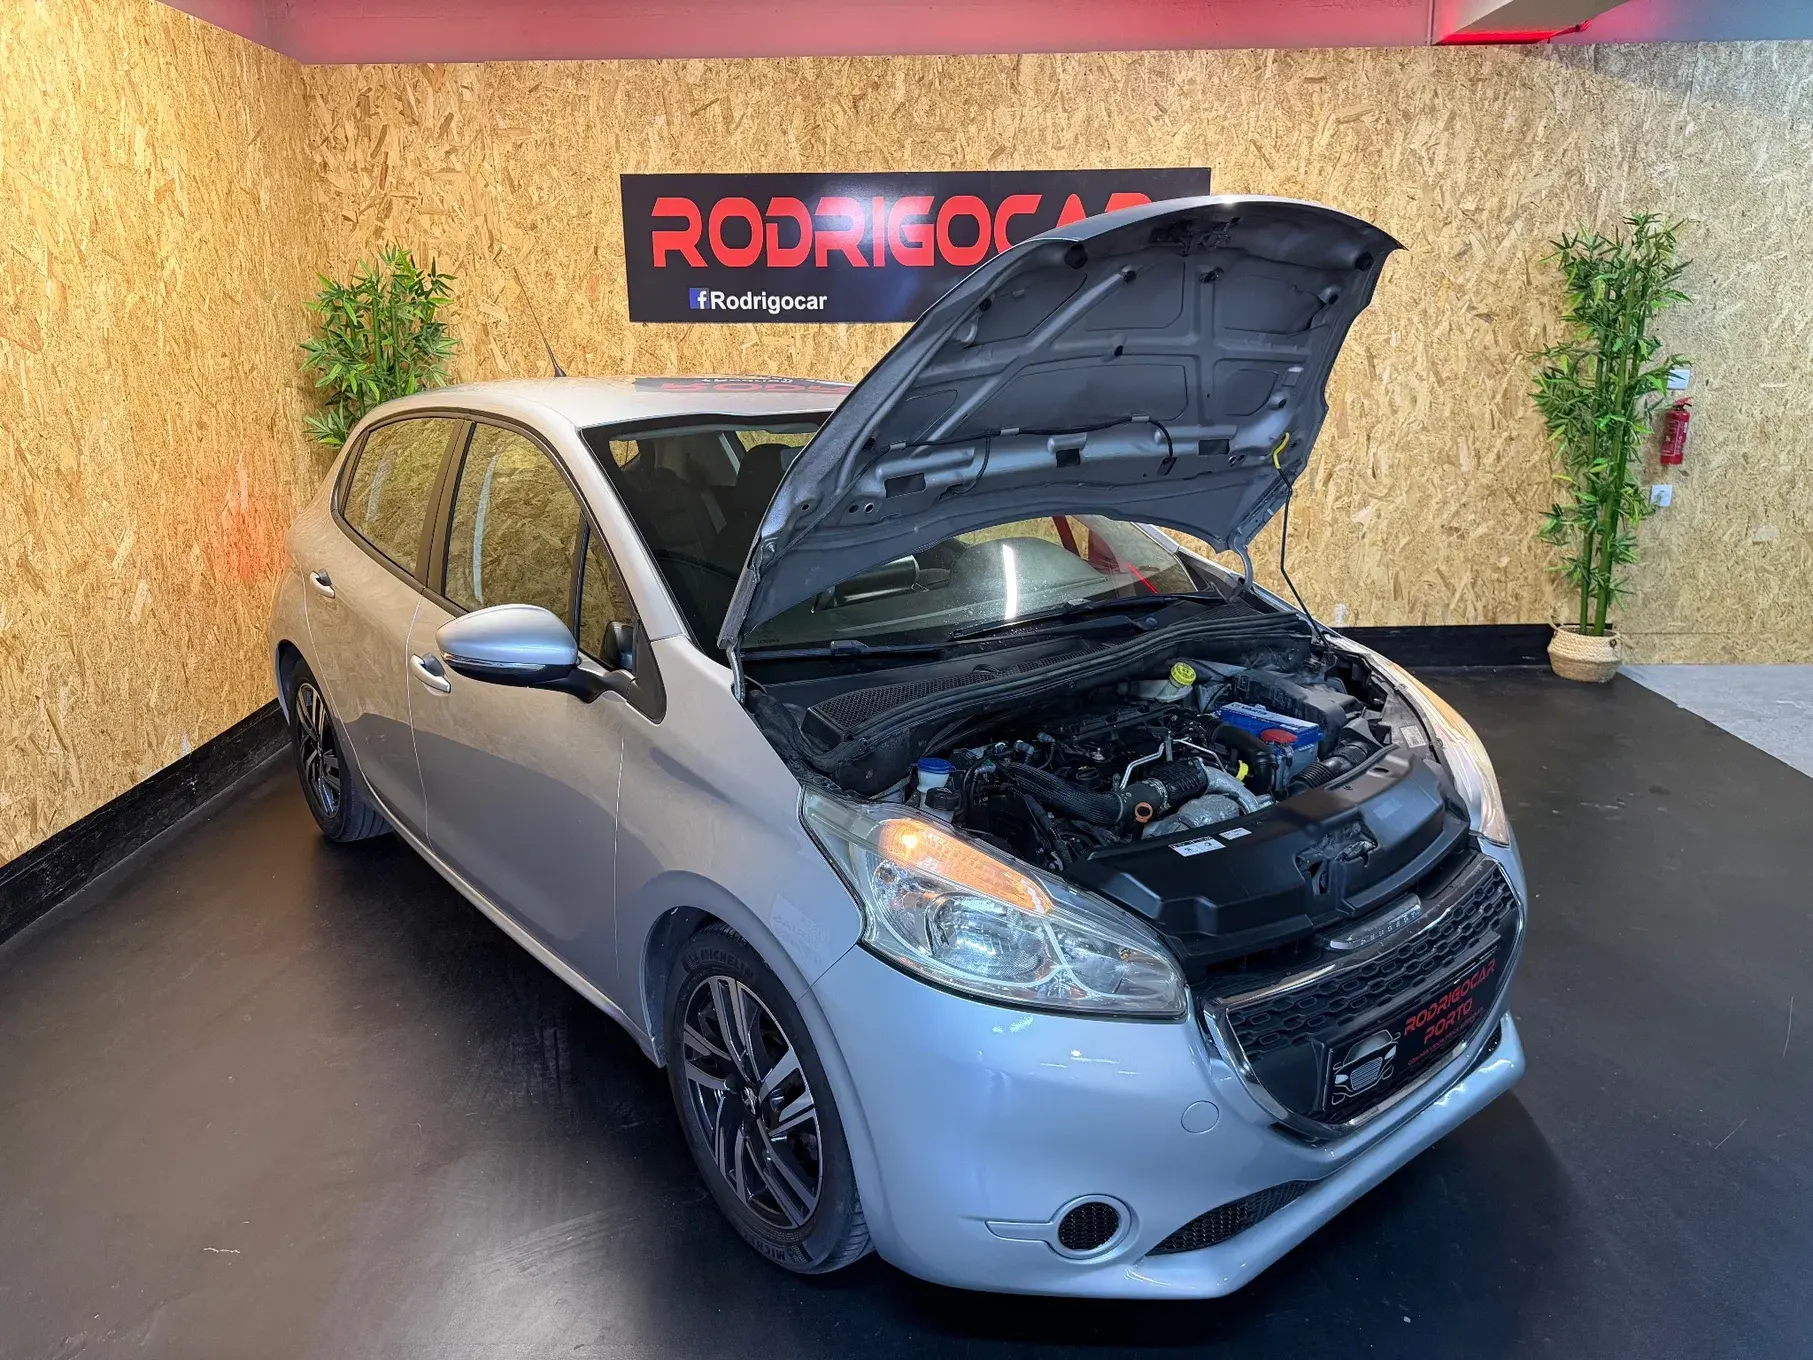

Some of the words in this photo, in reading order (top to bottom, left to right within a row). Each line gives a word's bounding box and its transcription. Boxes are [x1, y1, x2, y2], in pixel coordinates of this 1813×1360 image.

[651, 193, 1151, 268] RODRIGOC
[710, 291, 828, 315] Rodrigocar
[1403, 958, 1496, 1036] RODRIGOCAR
[1424, 997, 1473, 1044] PORTO
